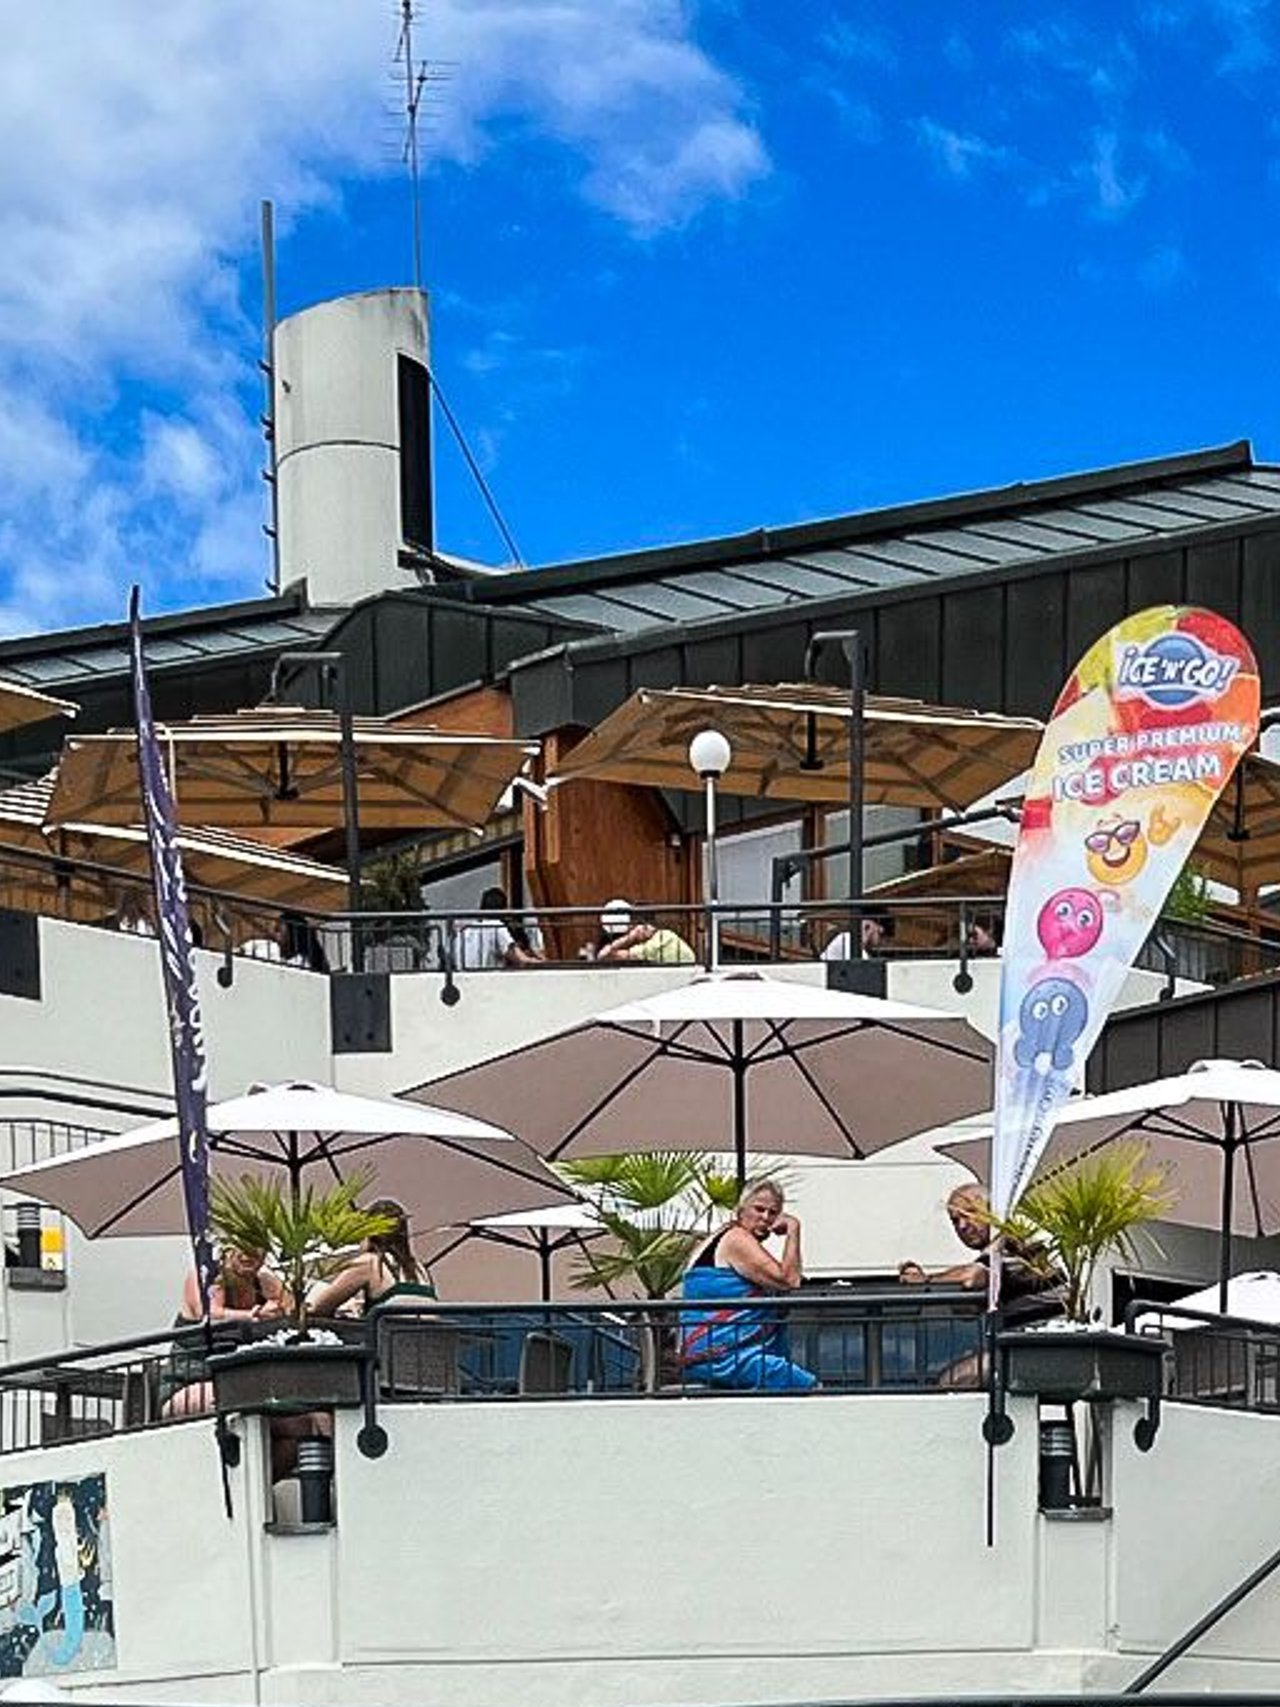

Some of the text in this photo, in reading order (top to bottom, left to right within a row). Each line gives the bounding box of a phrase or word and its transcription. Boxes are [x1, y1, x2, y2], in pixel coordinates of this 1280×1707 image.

[1059, 725, 1241, 764] SUPER PREMIUM
[1053, 753, 1221, 801] ICE CREAM
